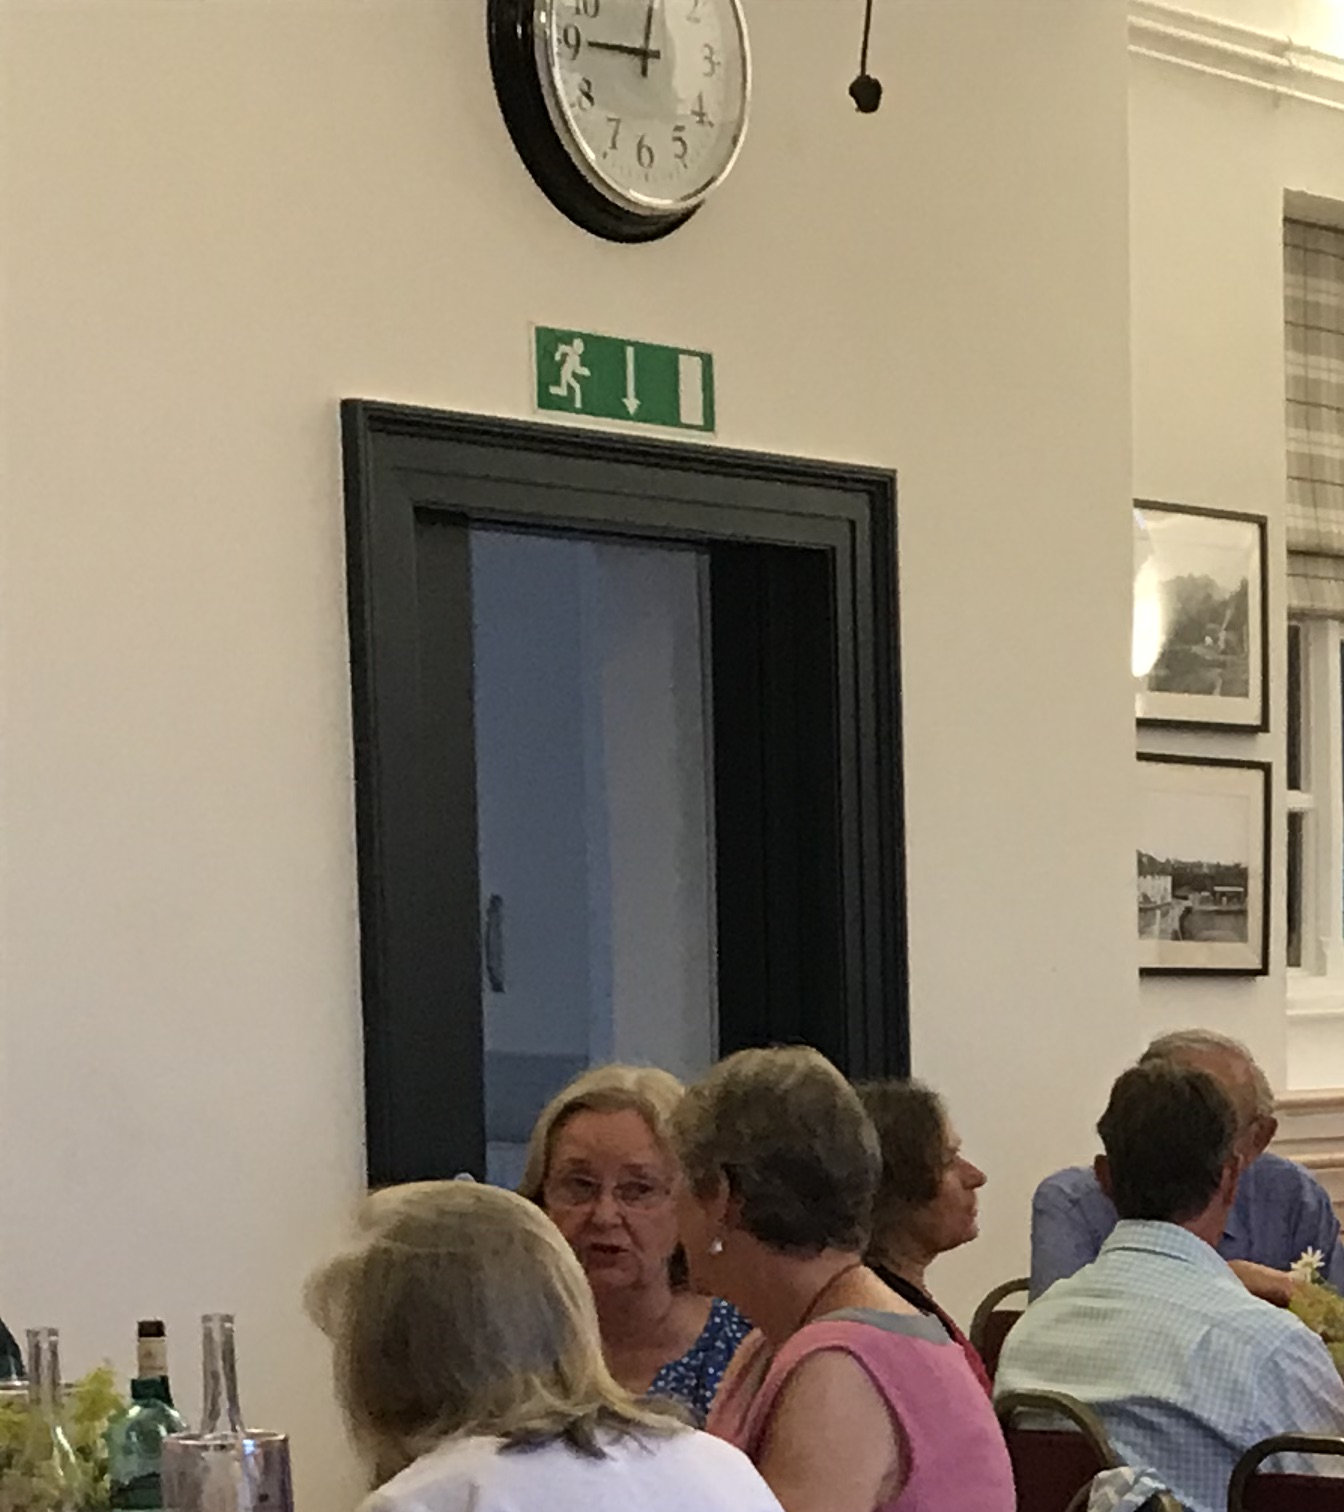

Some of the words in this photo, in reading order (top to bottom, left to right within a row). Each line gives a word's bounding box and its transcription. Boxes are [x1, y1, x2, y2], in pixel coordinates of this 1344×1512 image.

[563, 24, 581, 61] 9
[702, 43, 716, 77] 3
[578, 77, 595, 111] 8
[691, 90, 706, 126] 4
[606, 116, 621, 150] 7
[672, 125, 688, 159] 5
[637, 133, 655, 169] 6
